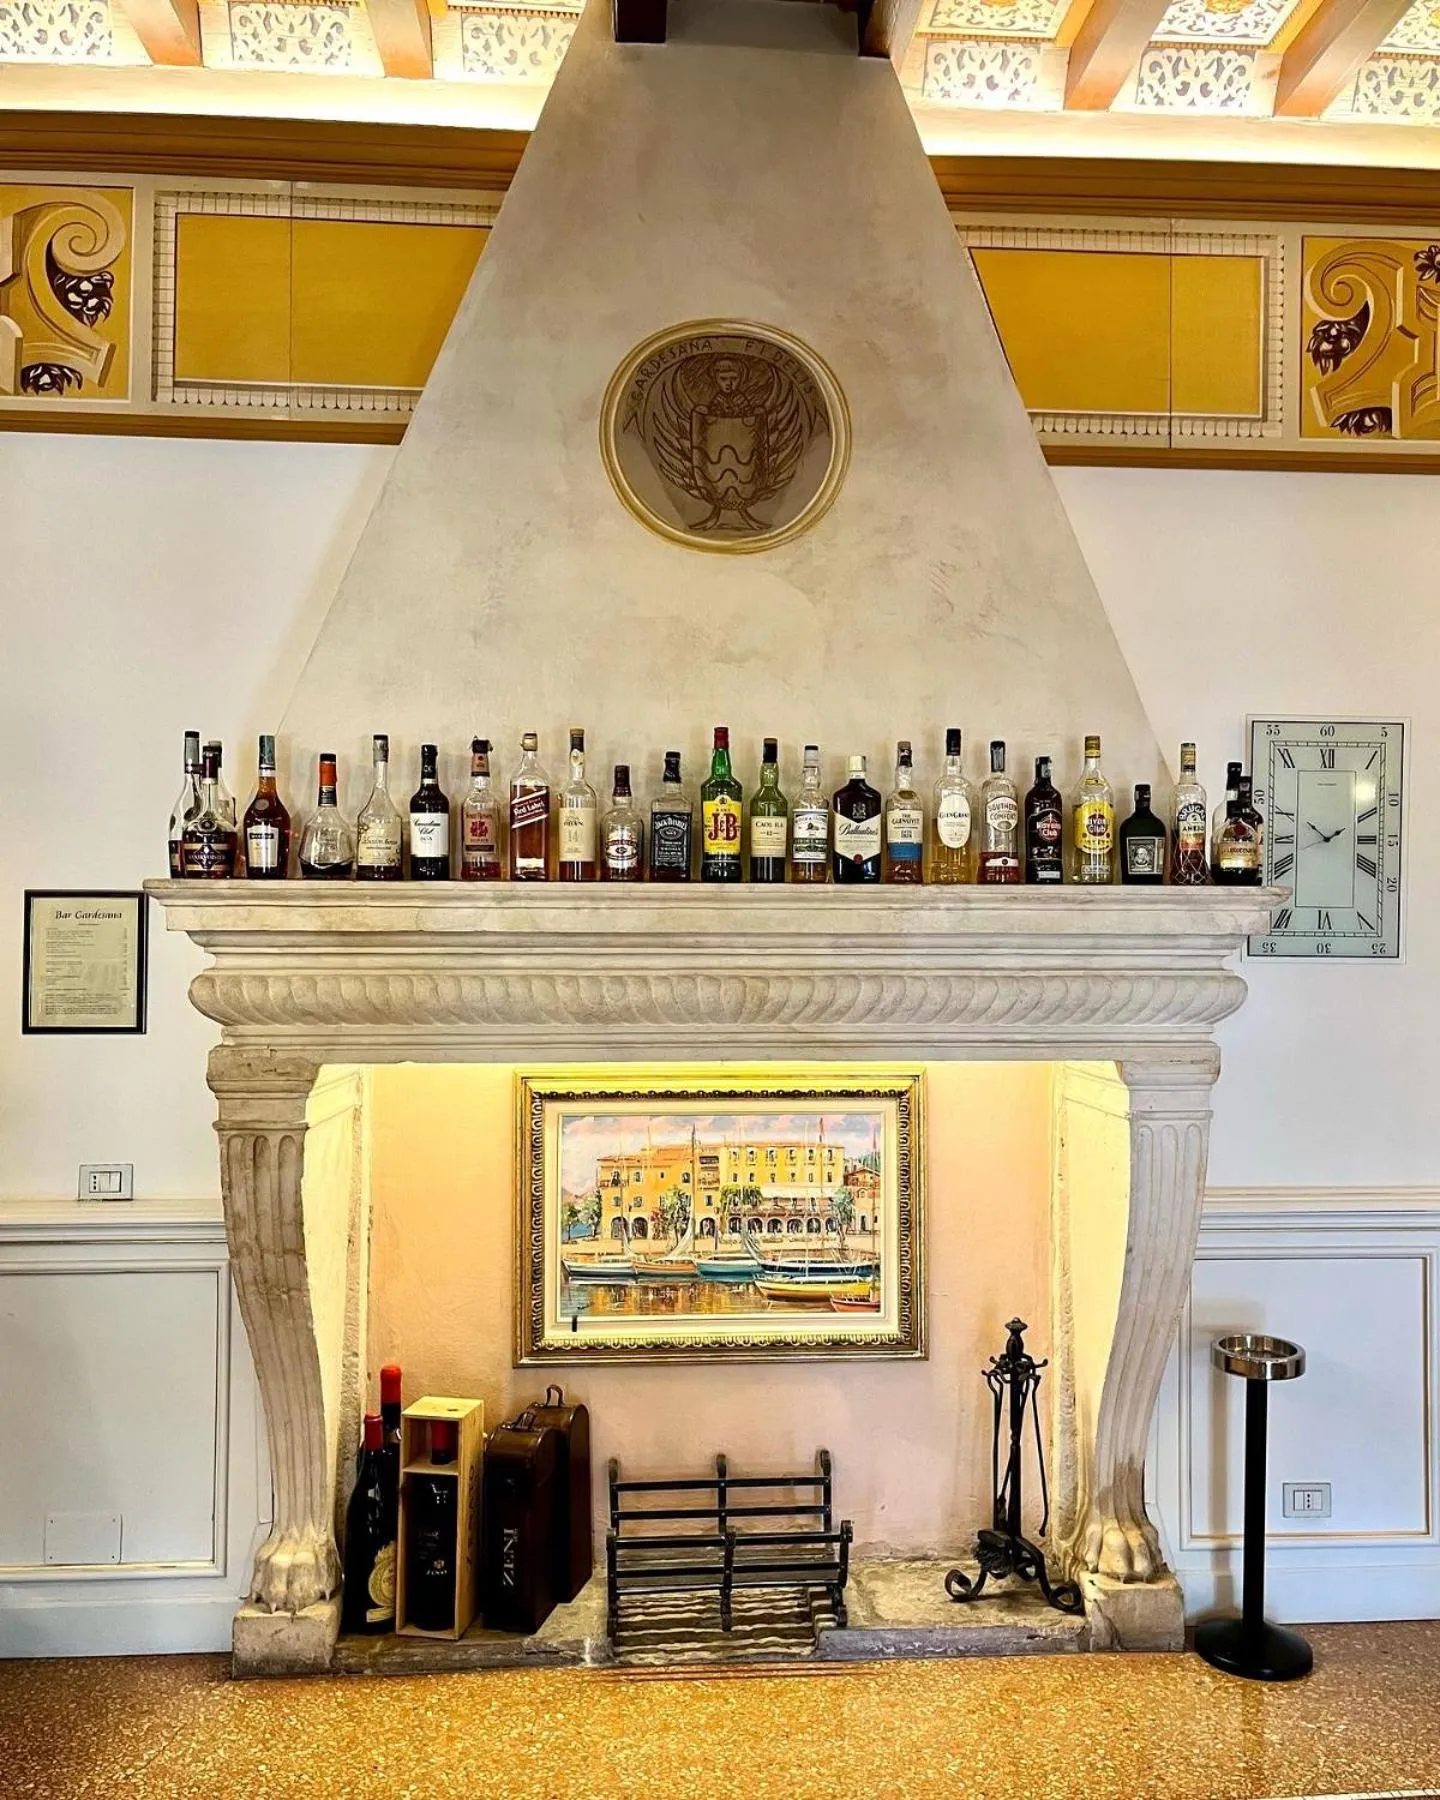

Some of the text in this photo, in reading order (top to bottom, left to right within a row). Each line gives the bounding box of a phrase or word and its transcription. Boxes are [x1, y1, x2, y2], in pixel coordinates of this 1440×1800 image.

[631, 339, 816, 401] GARDESANA FIDELIS
[1265, 725, 1280, 736] 55
[1319, 725, 1335, 737] 60
[1380, 726, 1388, 737] 5
[1320, 749, 1335, 769] XII
[1253, 789, 1265, 805] 50
[1388, 792, 1399, 807] 10
[513, 805, 527, 816] Red
[527, 801, 545, 811] Label
[1387, 834, 1399, 847] 15
[1386, 877, 1398, 893] 20
[55, 910, 72, 919] Bar
[1261, 942, 1277, 953] 35
[1316, 943, 1332, 954] 30
[1371, 943, 1387, 954] 25
[503, 1528, 514, 1586] ZENI
